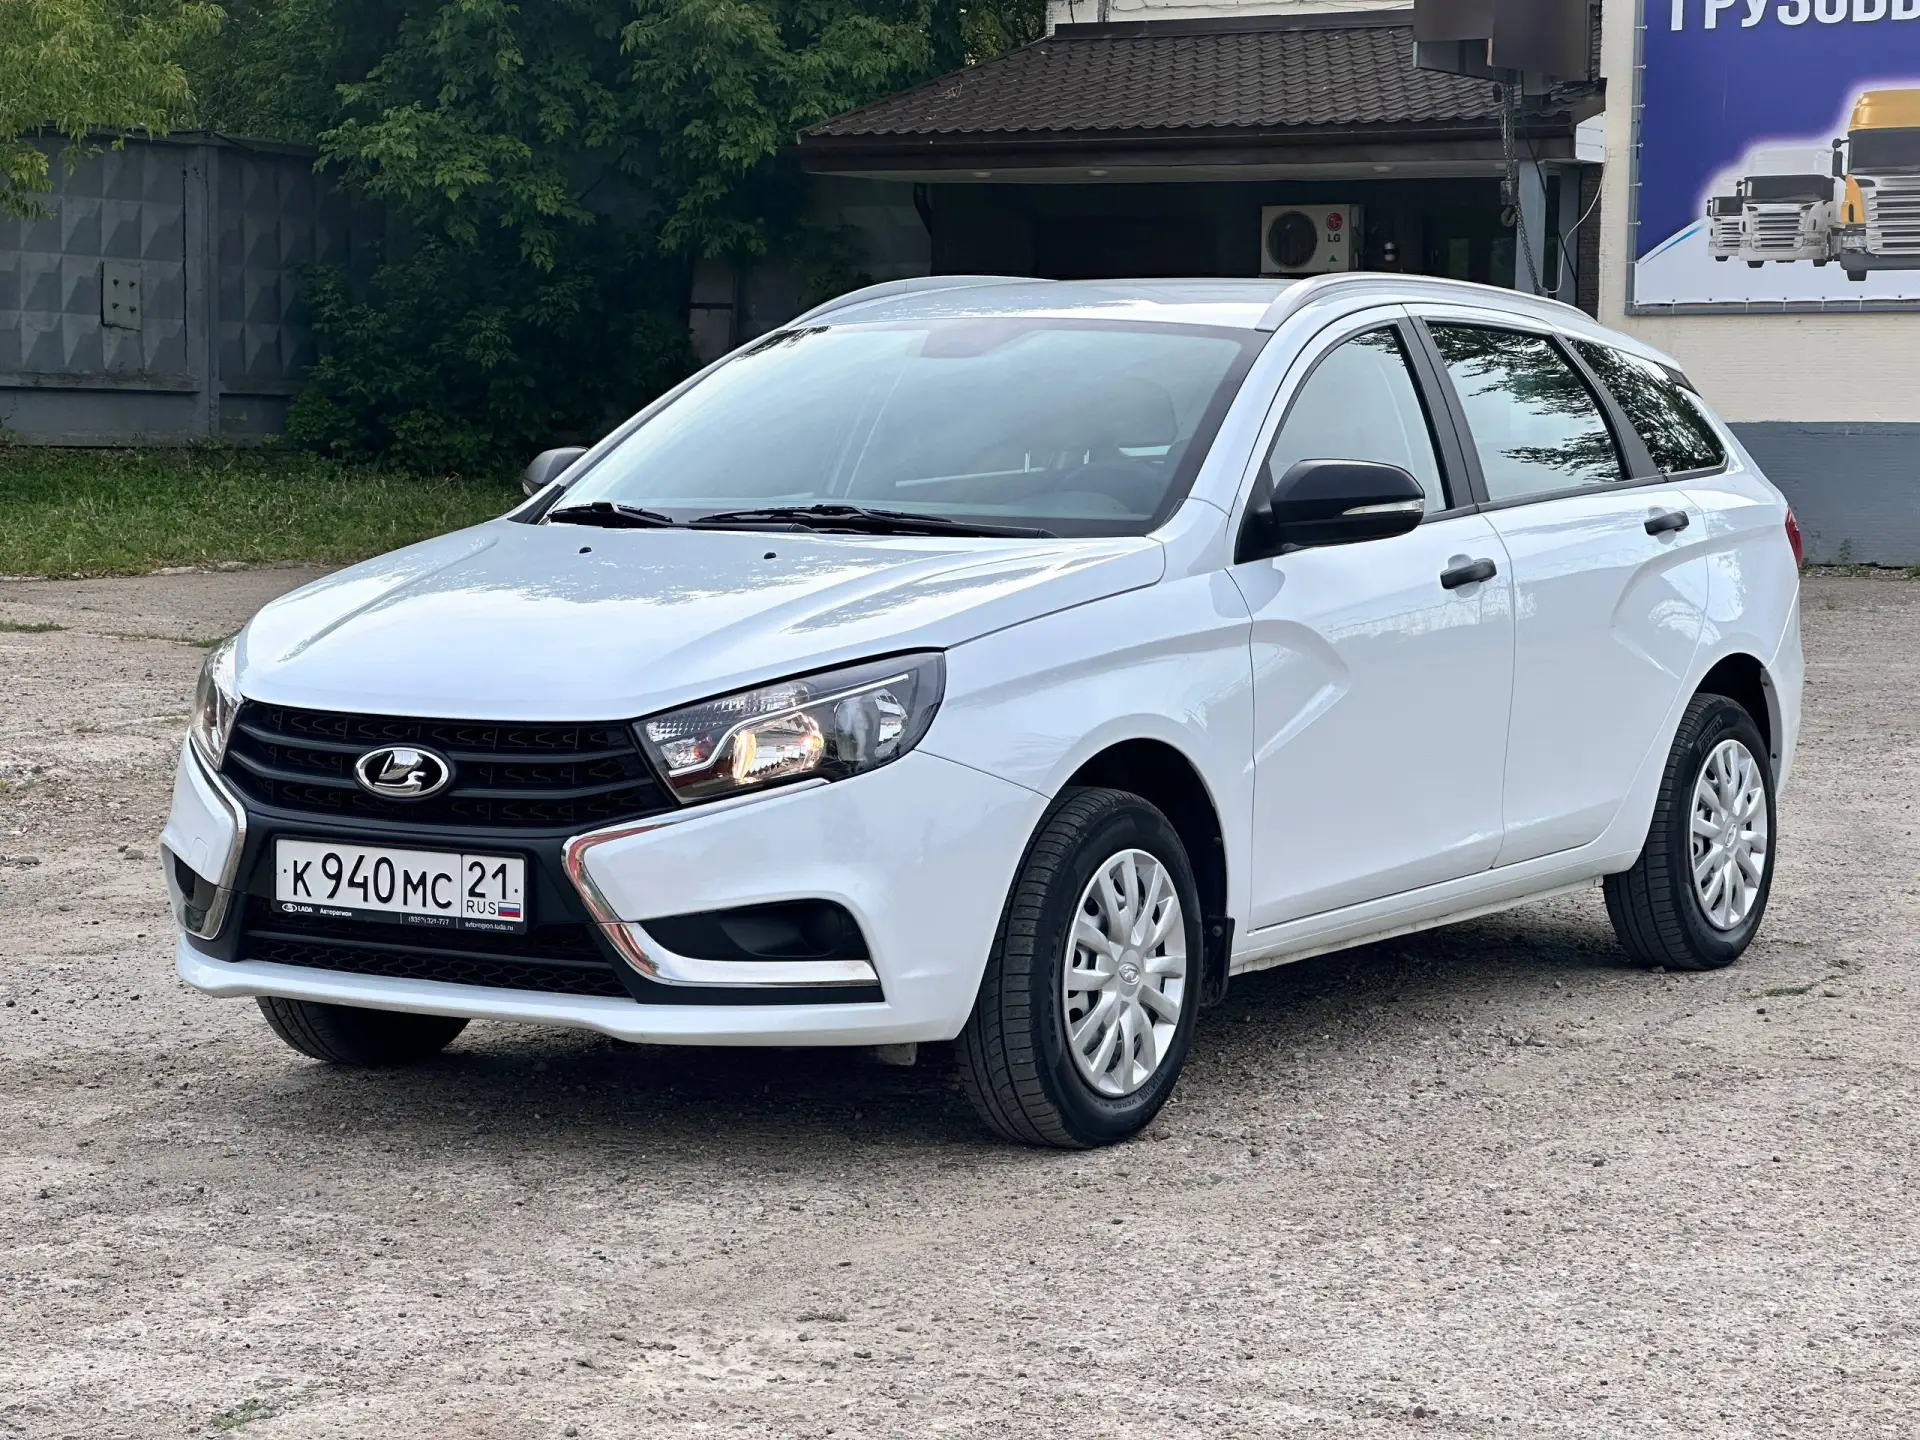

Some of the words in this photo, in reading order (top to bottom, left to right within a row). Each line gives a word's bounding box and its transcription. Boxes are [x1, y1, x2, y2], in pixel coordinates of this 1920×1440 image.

[1327, 233, 1341, 243] LG
[467, 861, 507, 900] 21
[297, 905, 313, 913] LADA
[466, 899, 496, 915] RUS
